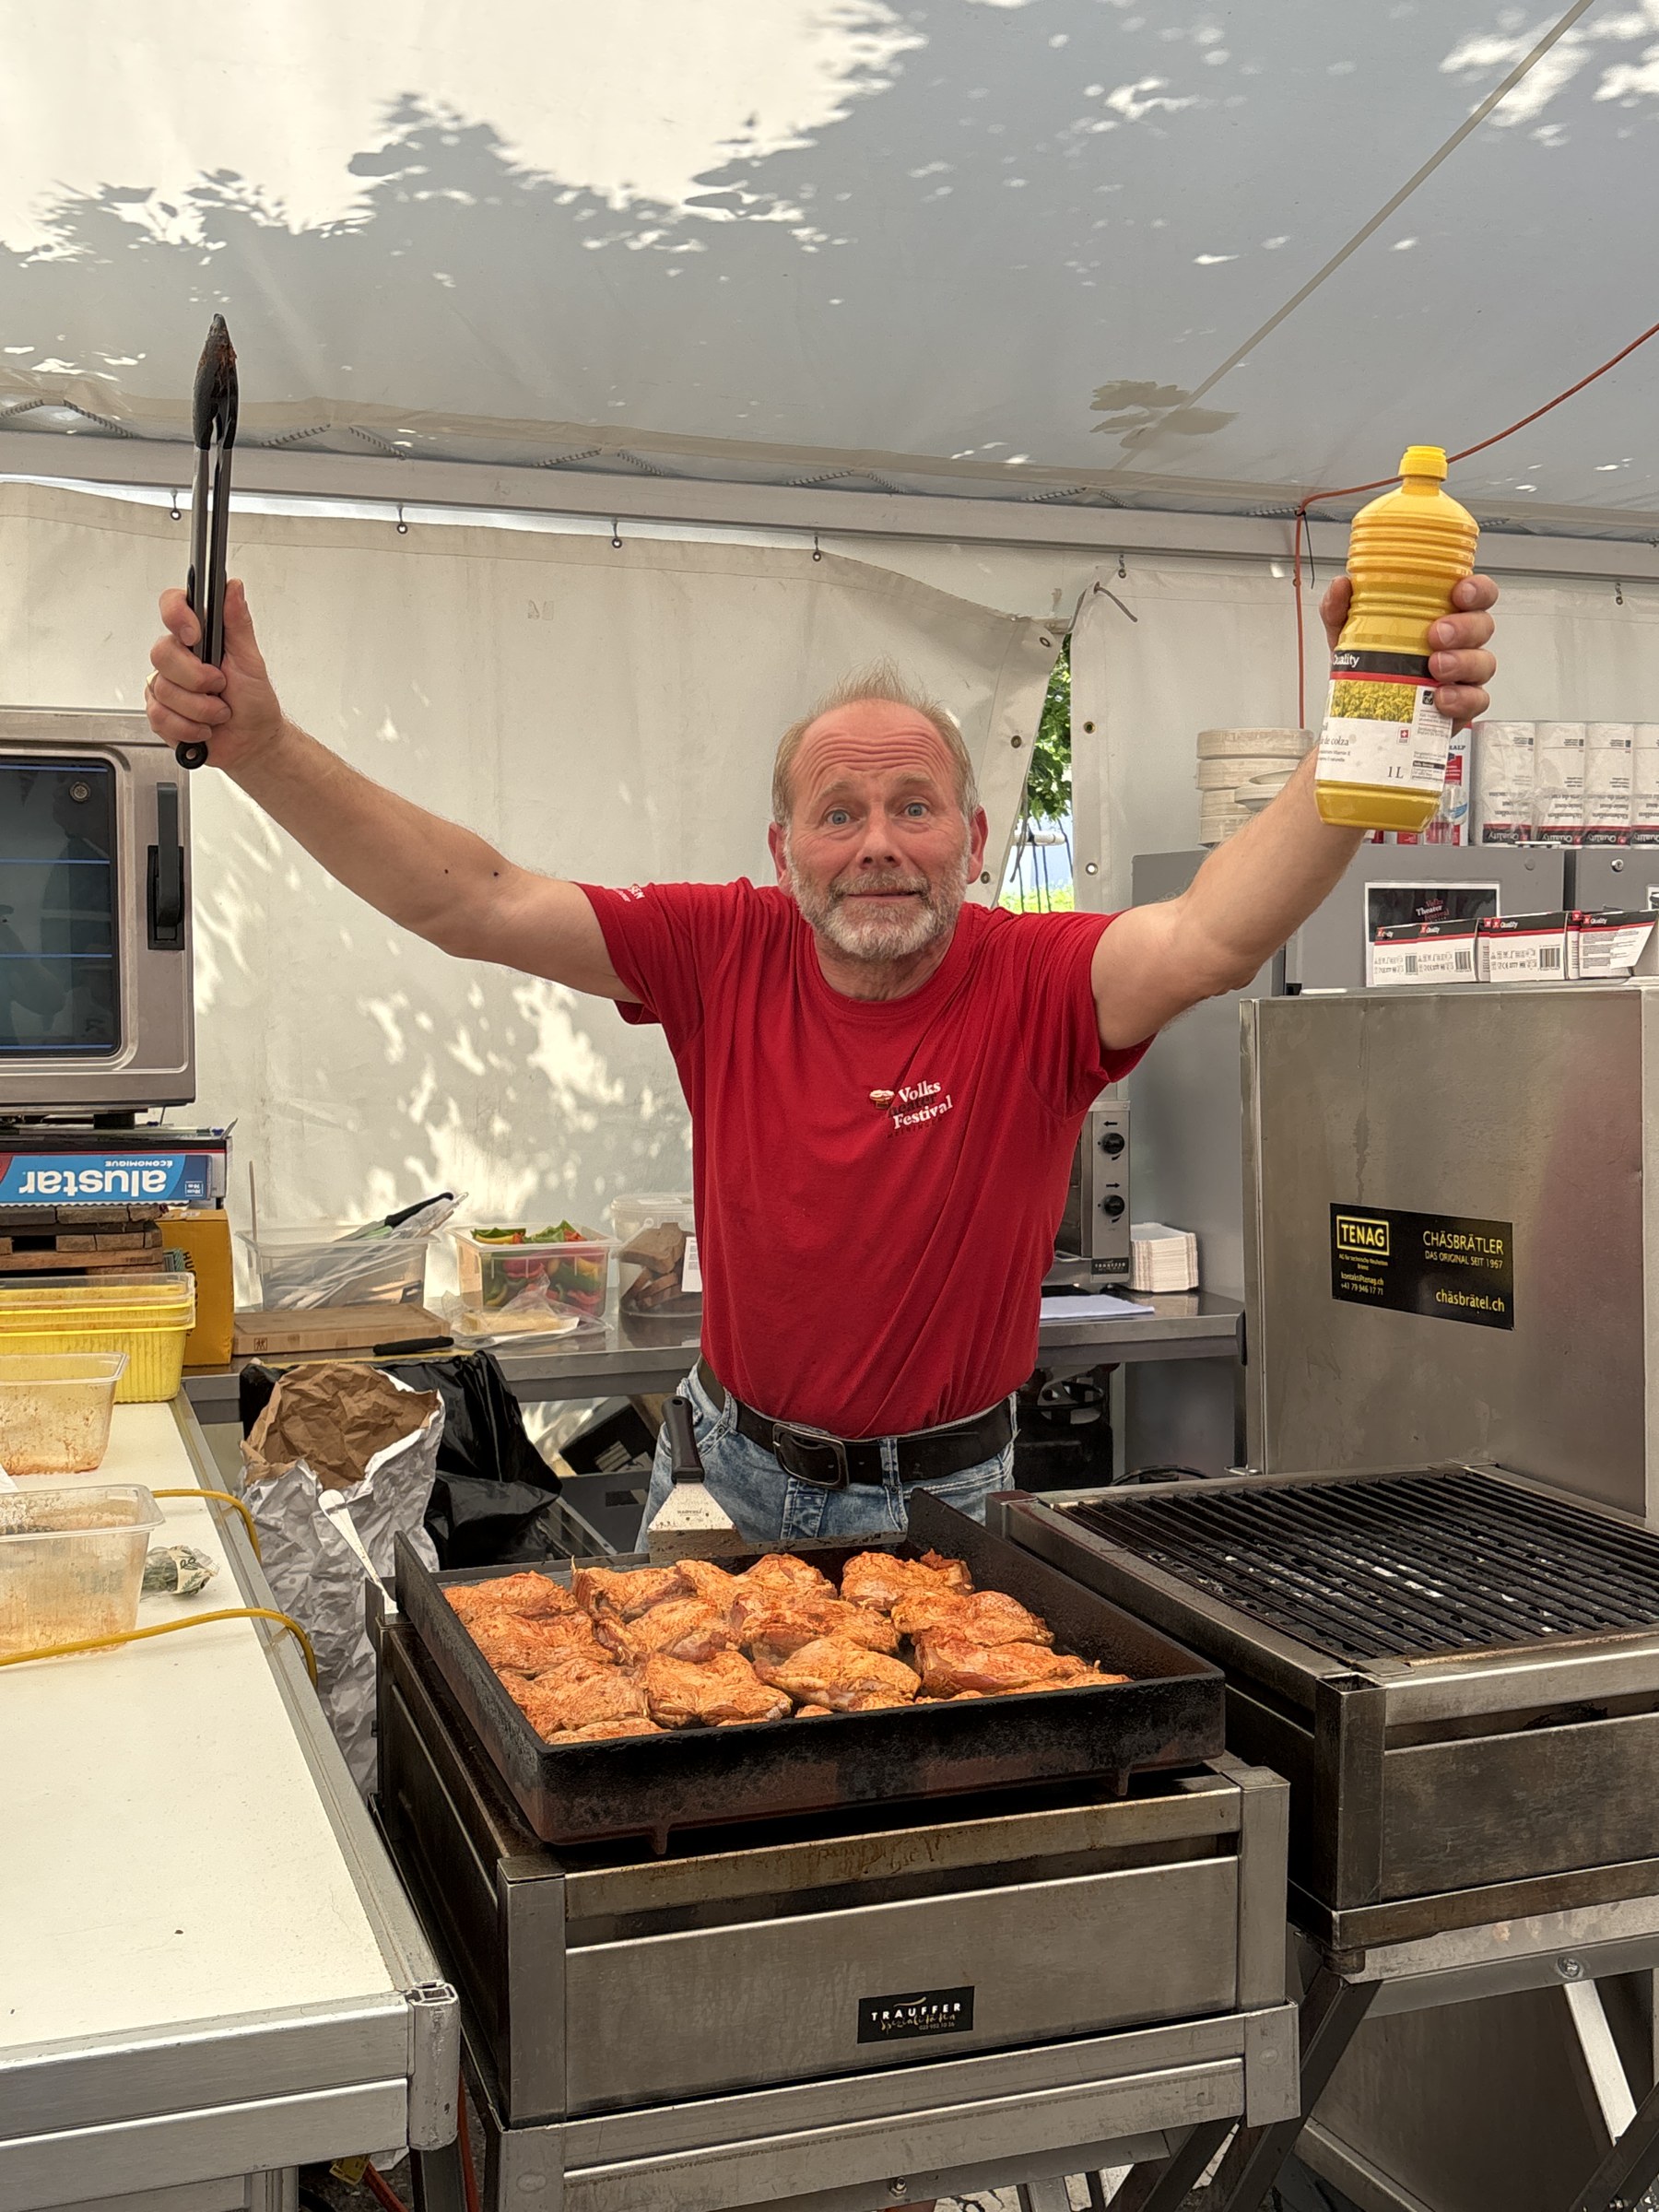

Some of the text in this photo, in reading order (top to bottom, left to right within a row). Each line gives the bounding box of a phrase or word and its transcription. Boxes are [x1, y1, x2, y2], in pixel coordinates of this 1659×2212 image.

[1331, 735, 1349, 747] colza
[1387, 766, 1393, 778] 1
[1395, 767, 1404, 779] L
[1488, 831, 1520, 841] Quality
[1542, 833, 1572, 843] Quality
[1588, 833, 1617, 843] Quality
[1416, 905, 1443, 917] Theater
[1500, 918, 1519, 929] Quality
[1590, 917, 1608, 925] Quality
[898, 1080, 942, 1103] Volks
[892, 1094, 954, 1130] Festival
[104, 1159, 173, 1169] ÉCONOMIQUE
[18, 1170, 167, 1196] alustar
[1341, 1224, 1385, 1248] TENAG
[1422, 1230, 1504, 1255] CHÄSBRÄTLER
[1425, 1251, 1504, 1269] DAS ORIGINAL SEIT 1967
[1435, 1288, 1505, 1312] chäsbrätel.ch
[871, 2003, 961, 2021] TRAUFFER
